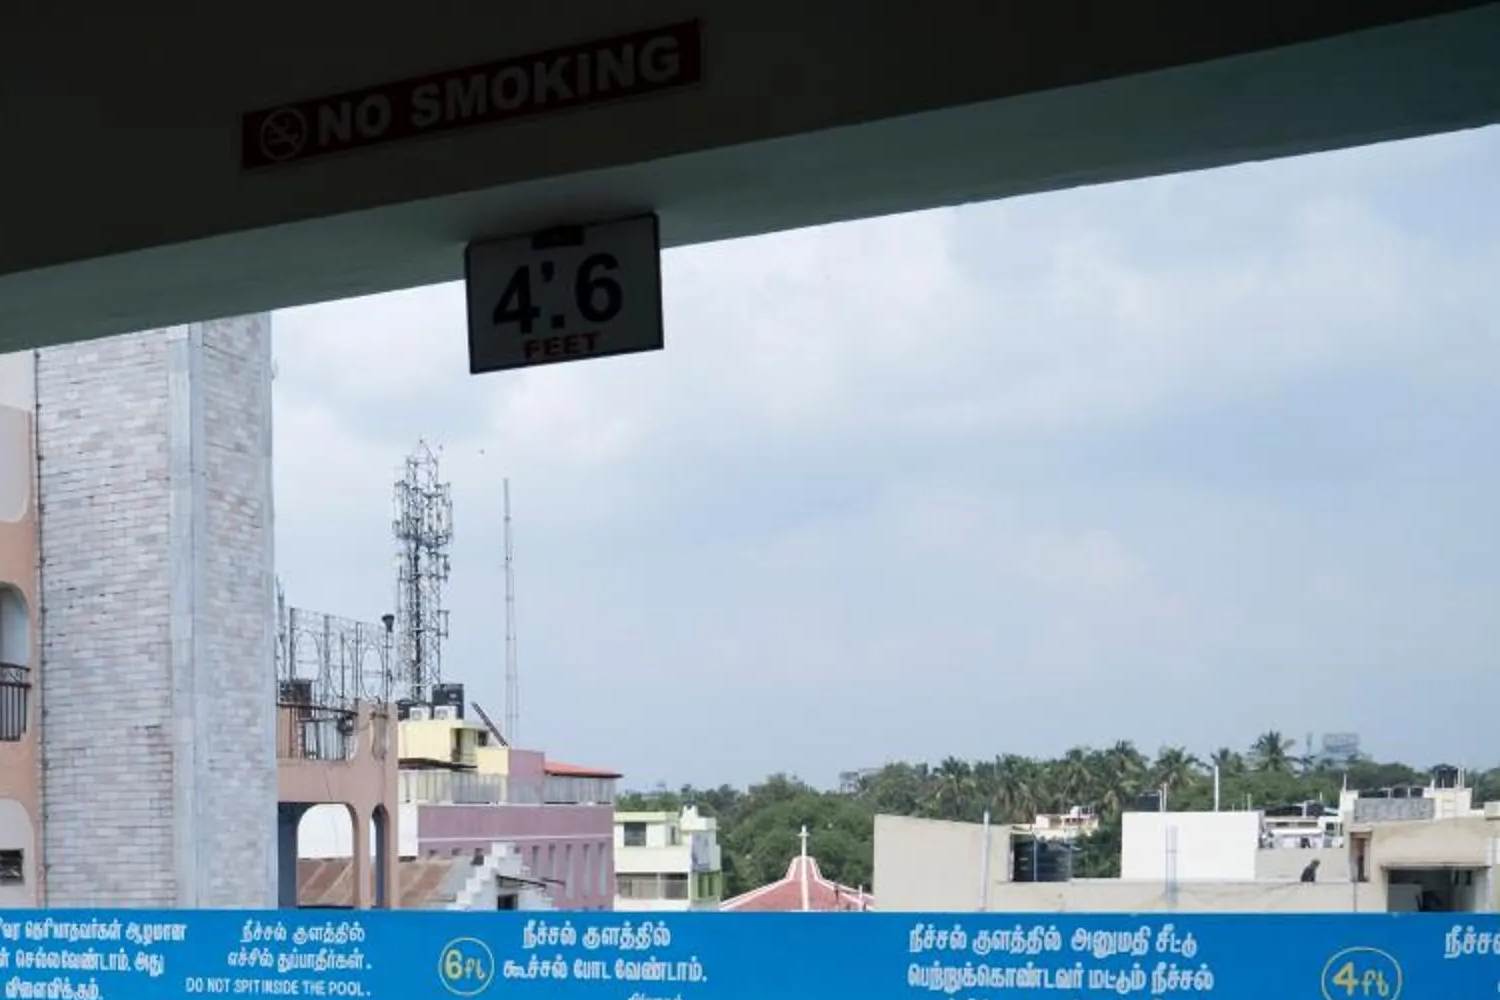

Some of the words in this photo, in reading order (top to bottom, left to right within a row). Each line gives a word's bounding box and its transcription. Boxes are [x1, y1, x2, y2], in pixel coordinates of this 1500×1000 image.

[315, 97, 394, 147] NO
[410, 36, 680, 128] SMOKING
[524, 332, 601, 359] FEET
[240, 918, 288, 943] நீச்சல்
[291, 921, 366, 945] குளத்தில்
[522, 919, 577, 949] நீச்சல்
[581, 921, 671, 950] குளத்தில்
[909, 922, 968, 953] நீச்சல்
[972, 923, 1062, 955] குளத்தில்
[1071, 925, 1151, 959] அனுமதி
[1155, 922, 1198, 957] சீட்டு
[227, 946, 275, 968] எச்சில்
[502, 953, 569, 980] கூச்சல்
[572, 958, 611, 980] போட
[614, 955, 708, 983] வேண்டாம்.
[185, 977, 204, 993] DO
[206, 977, 231, 993] NOT
[233, 978, 261, 994] SPIT
[262, 979, 300, 995] INSIDE
[303, 980, 326, 996] THE
[328, 981, 372, 997] POOL.
[907, 959, 1084, 994] பெற்றுக்கொண்டவர்
[1088, 961, 1148, 995] மட்டும்
[1150, 960, 1215, 994] நீச்சல்
